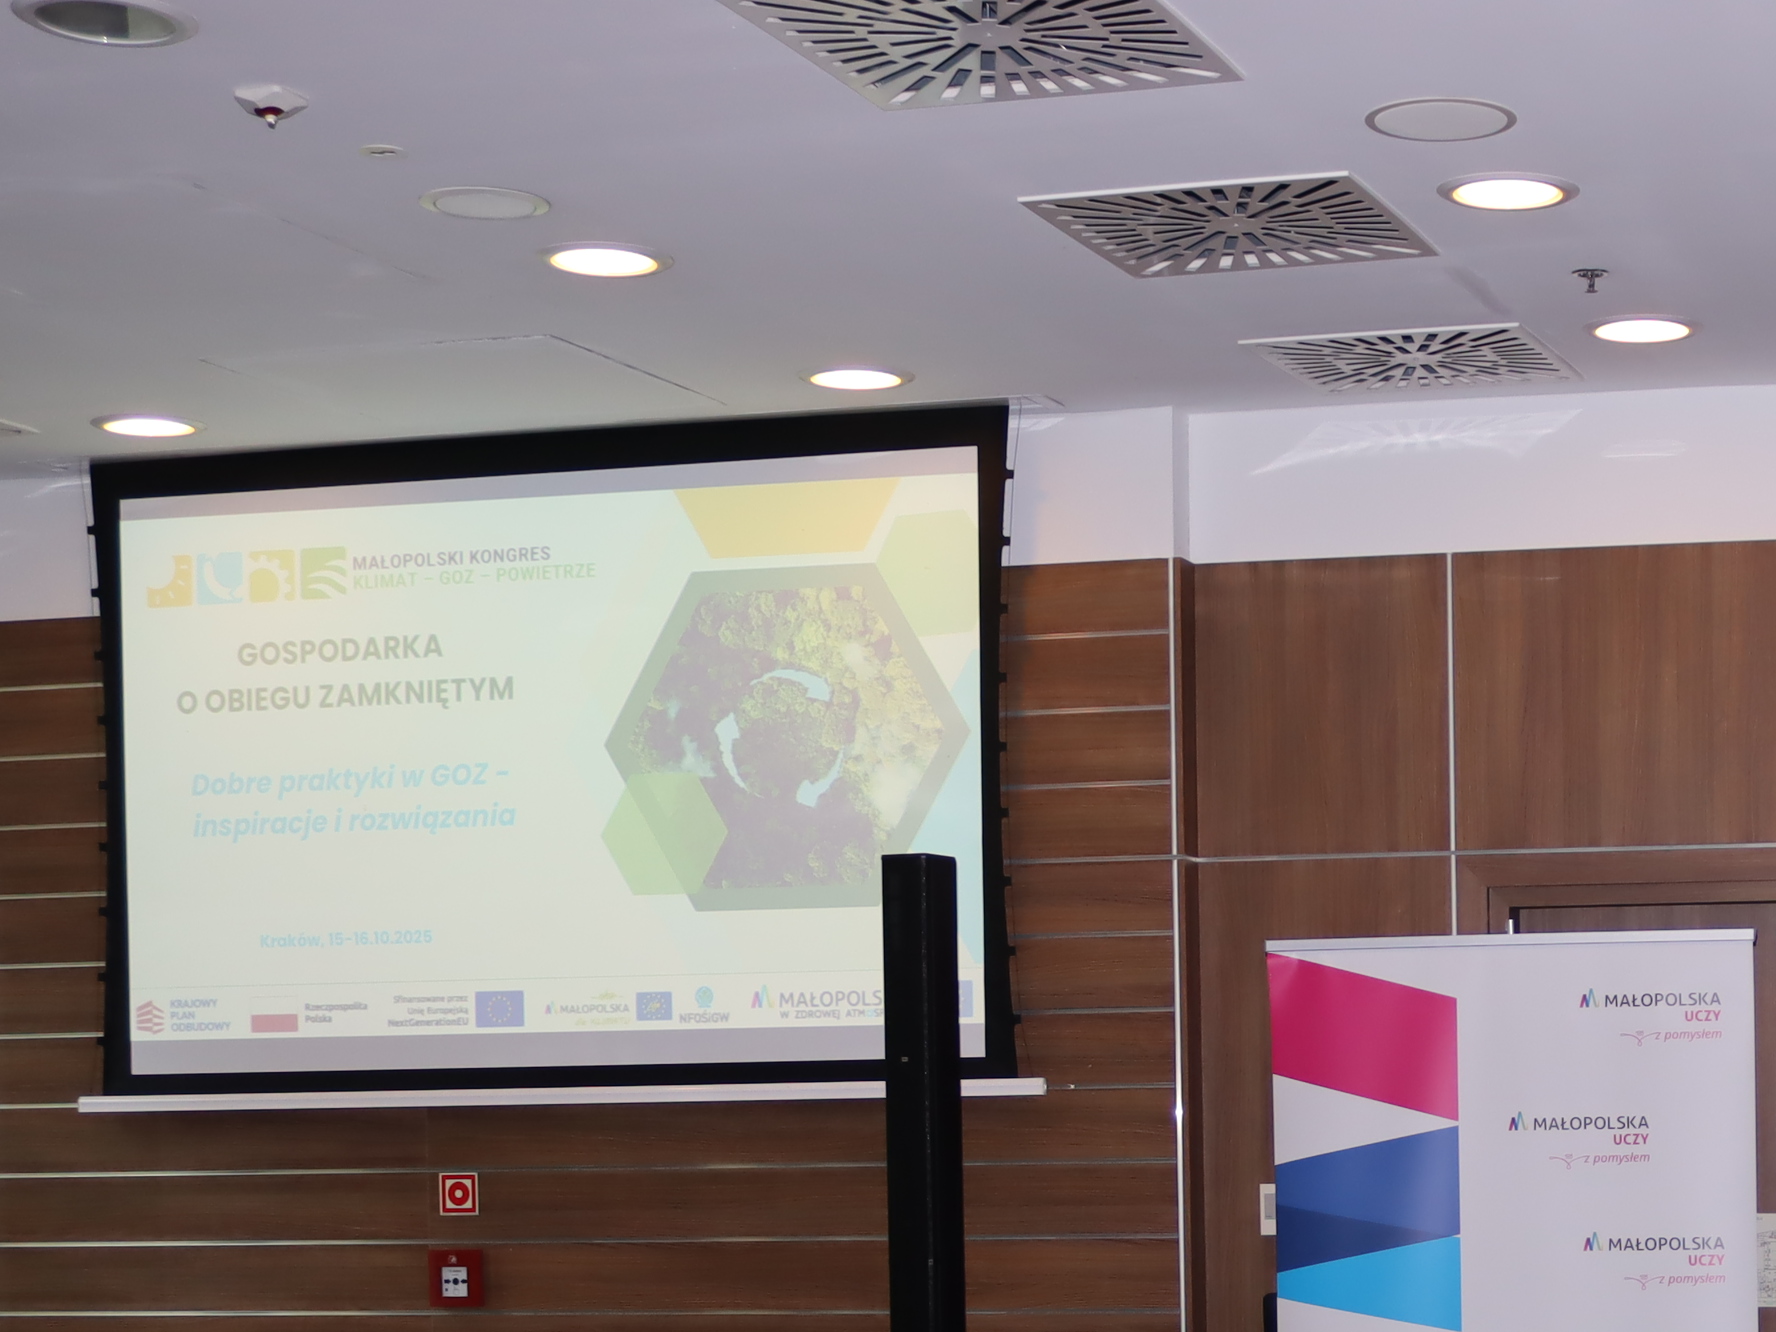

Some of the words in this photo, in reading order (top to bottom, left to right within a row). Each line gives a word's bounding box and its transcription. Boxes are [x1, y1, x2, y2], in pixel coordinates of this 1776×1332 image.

[352, 550, 463, 572] MAŁOPOLSKI
[469, 545, 551, 564] KONGRES
[353, 572, 418, 590] KLIMAT
[439, 569, 474, 585] GOZ
[496, 563, 597, 582] POWIETRZE
[237, 634, 443, 666] GOSPODARKA
[177, 691, 198, 715] O
[205, 684, 311, 714] OBIEGU
[318, 676, 514, 710] ZAMKNIĘTYM
[192, 771, 273, 797] Dobre
[278, 763, 396, 800] praktyki
[402, 767, 425, 788] w
[430, 762, 489, 787] GOZ
[193, 808, 328, 844] inspiracje
[334, 807, 343, 833] i
[348, 801, 517, 835] rozwiązania
[260, 932, 325, 950] Kraków,
[328, 928, 433, 947] 15-16.10.2025
[170, 998, 218, 1009] KRAJOWY
[779, 989, 883, 1008] MAŁOPOLS
[1604, 992, 1721, 1008] MAŁOPOLSKA
[560, 1003, 630, 1014] MAŁOPOLSKA
[779, 1010, 790, 1019] W
[794, 1009, 840, 1020] ZDROWEJ
[170, 1011, 195, 1021] PLAN
[1684, 1010, 1721, 1022] UCZY
[171, 1021, 231, 1032] ODBUDOWY
[1664, 1028, 1722, 1042] pomysłem
[1533, 1115, 1649, 1131] MAŁOPOLSKA
[1613, 1133, 1649, 1145] UCZY
[1593, 1152, 1650, 1166] pomysłem
[1608, 1236, 1725, 1251] MAŁOPOLSKA
[1688, 1254, 1725, 1266] UCZY
[1667, 1273, 1726, 1287] pomysłem
